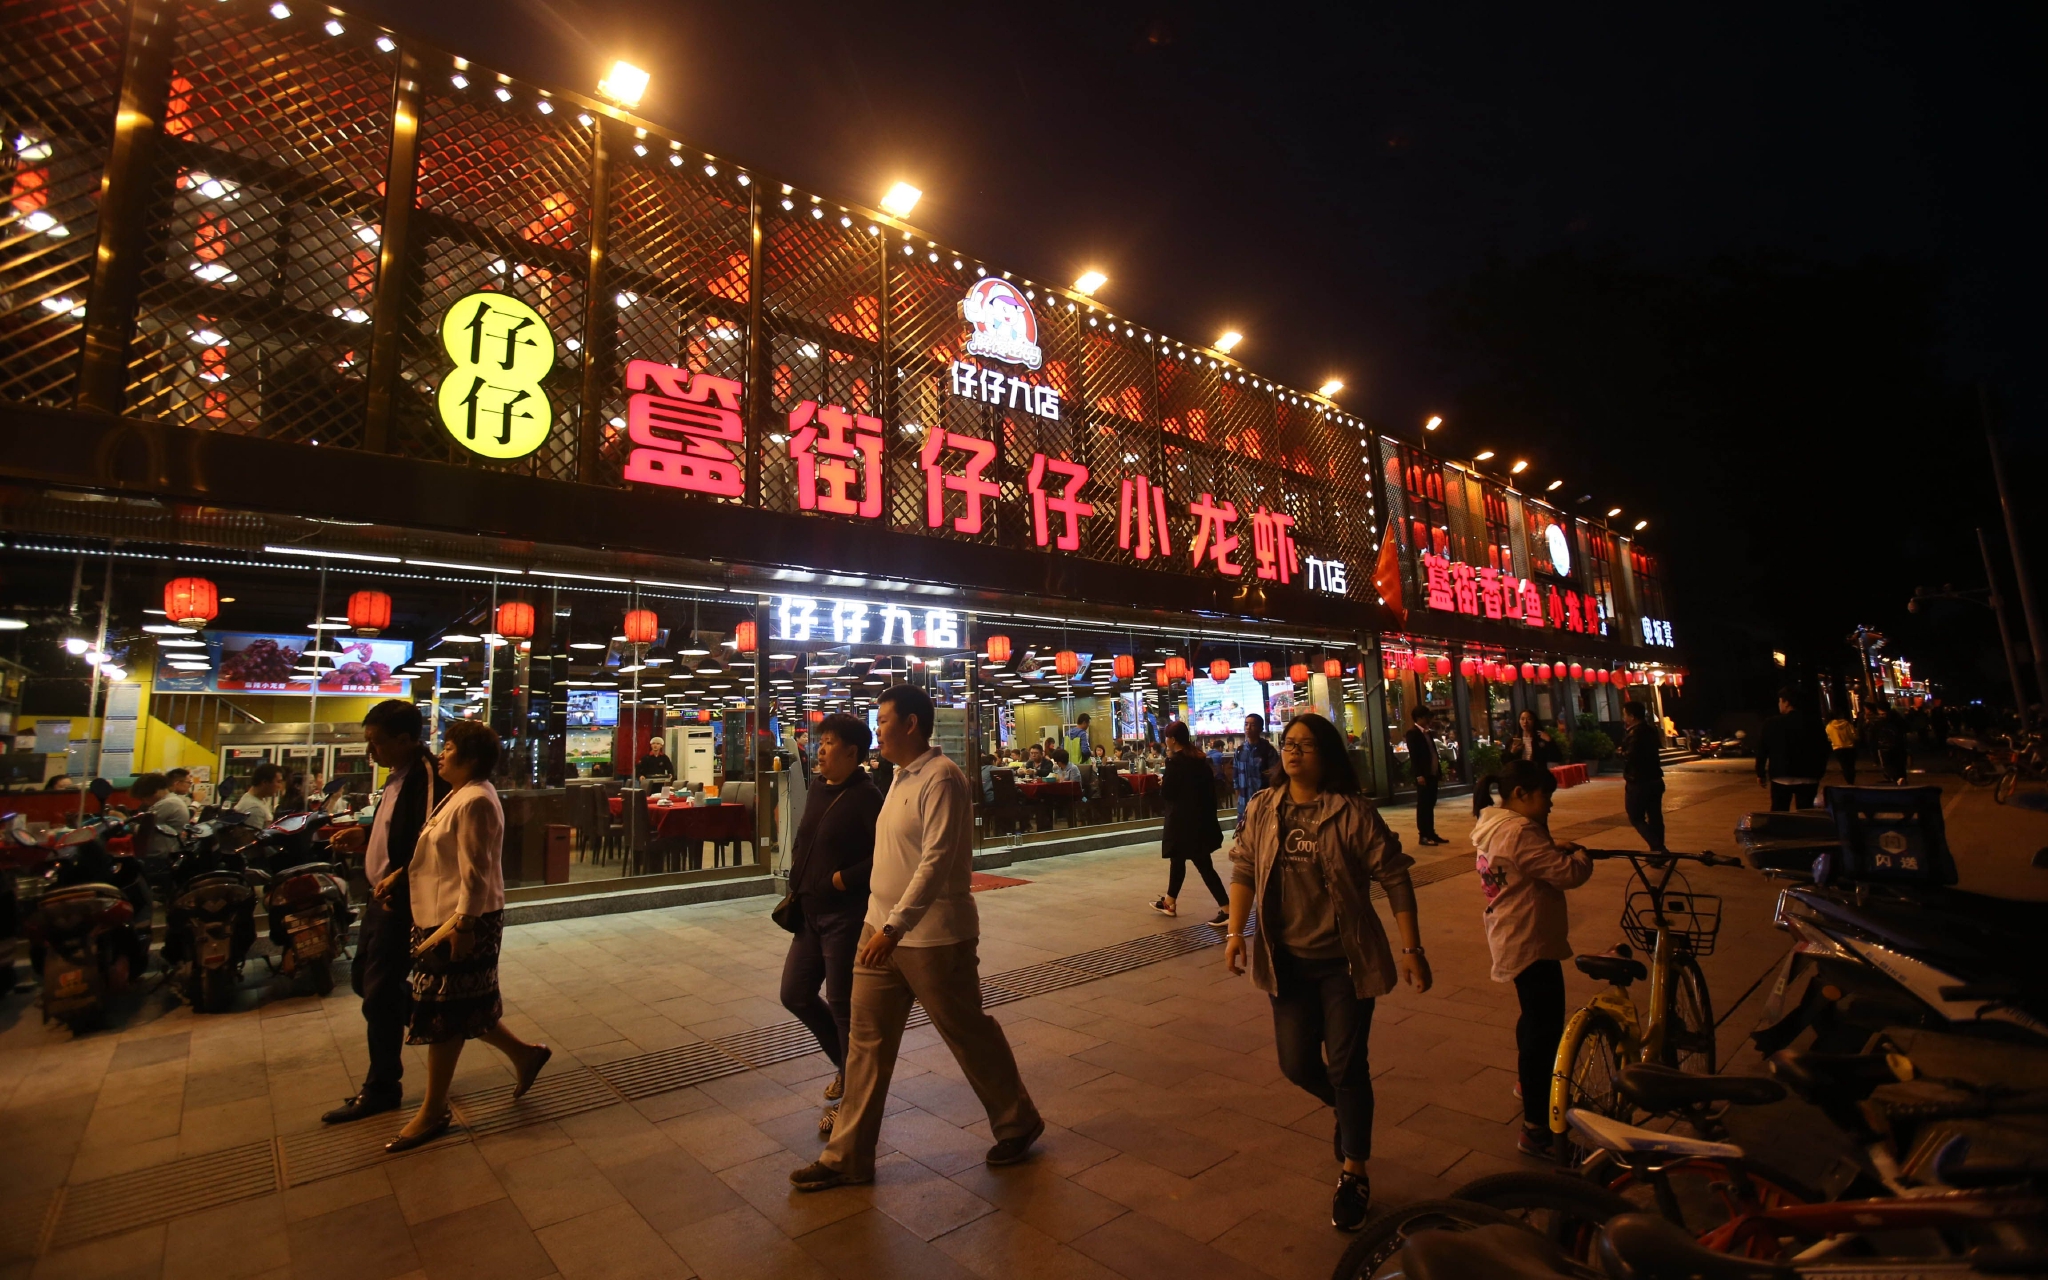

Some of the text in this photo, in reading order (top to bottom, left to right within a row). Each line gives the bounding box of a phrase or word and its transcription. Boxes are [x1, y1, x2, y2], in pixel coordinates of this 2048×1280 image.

[951, 361, 1060, 421] 仔仔九店
[1305, 555, 1347, 594] 九店
[778, 595, 958, 648] 仔仔九店
[244, 681, 286, 690] 麻辣小龙虾
[340, 684, 381, 692] 麻辣小龙虾
[1876, 854, 1919, 870] 闪送
